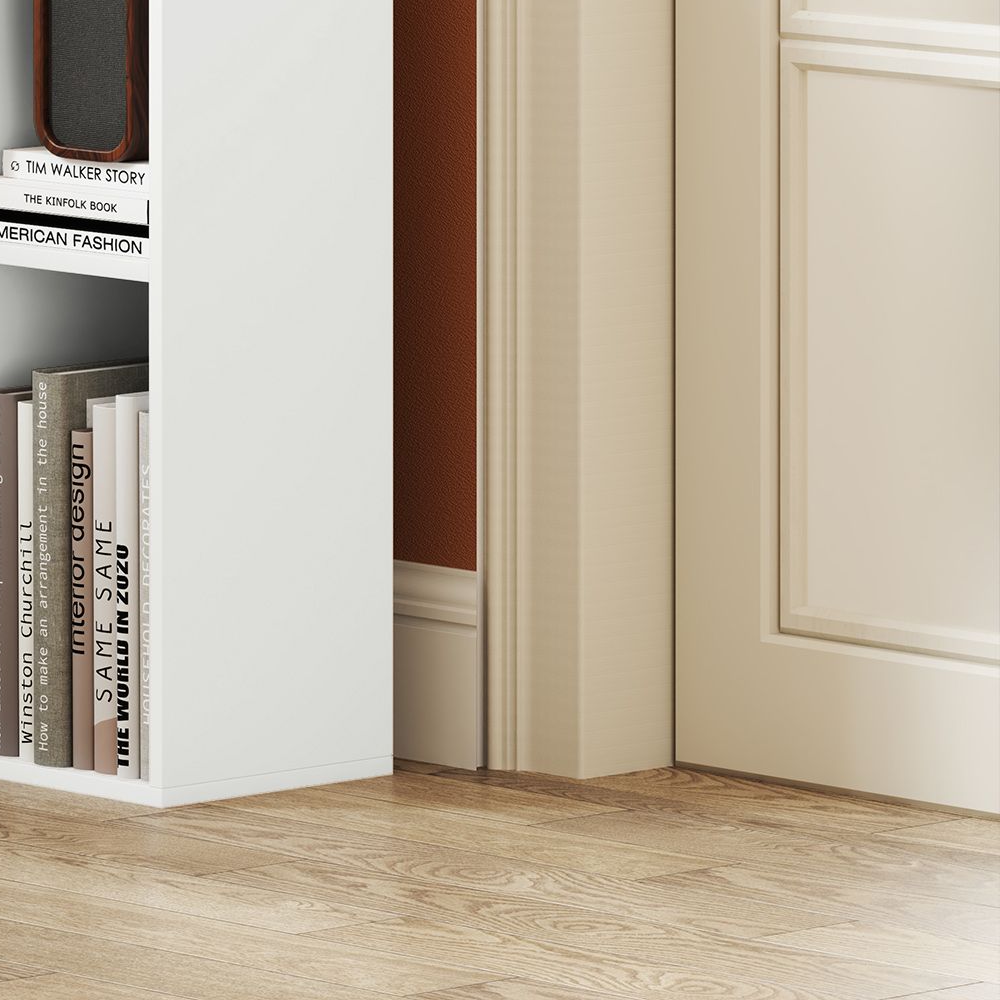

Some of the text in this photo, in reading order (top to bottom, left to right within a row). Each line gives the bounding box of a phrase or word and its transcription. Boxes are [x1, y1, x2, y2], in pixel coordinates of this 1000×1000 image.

[24, 194, 118, 213] THE KINFOLK BOOK
[26, 160, 146, 185] TIM WALKER STORY
[73, 234, 142, 254] FASHION
[20, 521, 33, 744] Winston Churchill
[37, 382, 50, 751] How to make an arrangement in the house
[72, 444, 91, 655] Interior design
[95, 520, 112, 702] SAME SAME
[117, 544, 130, 767] THE WORLD IN 2020
